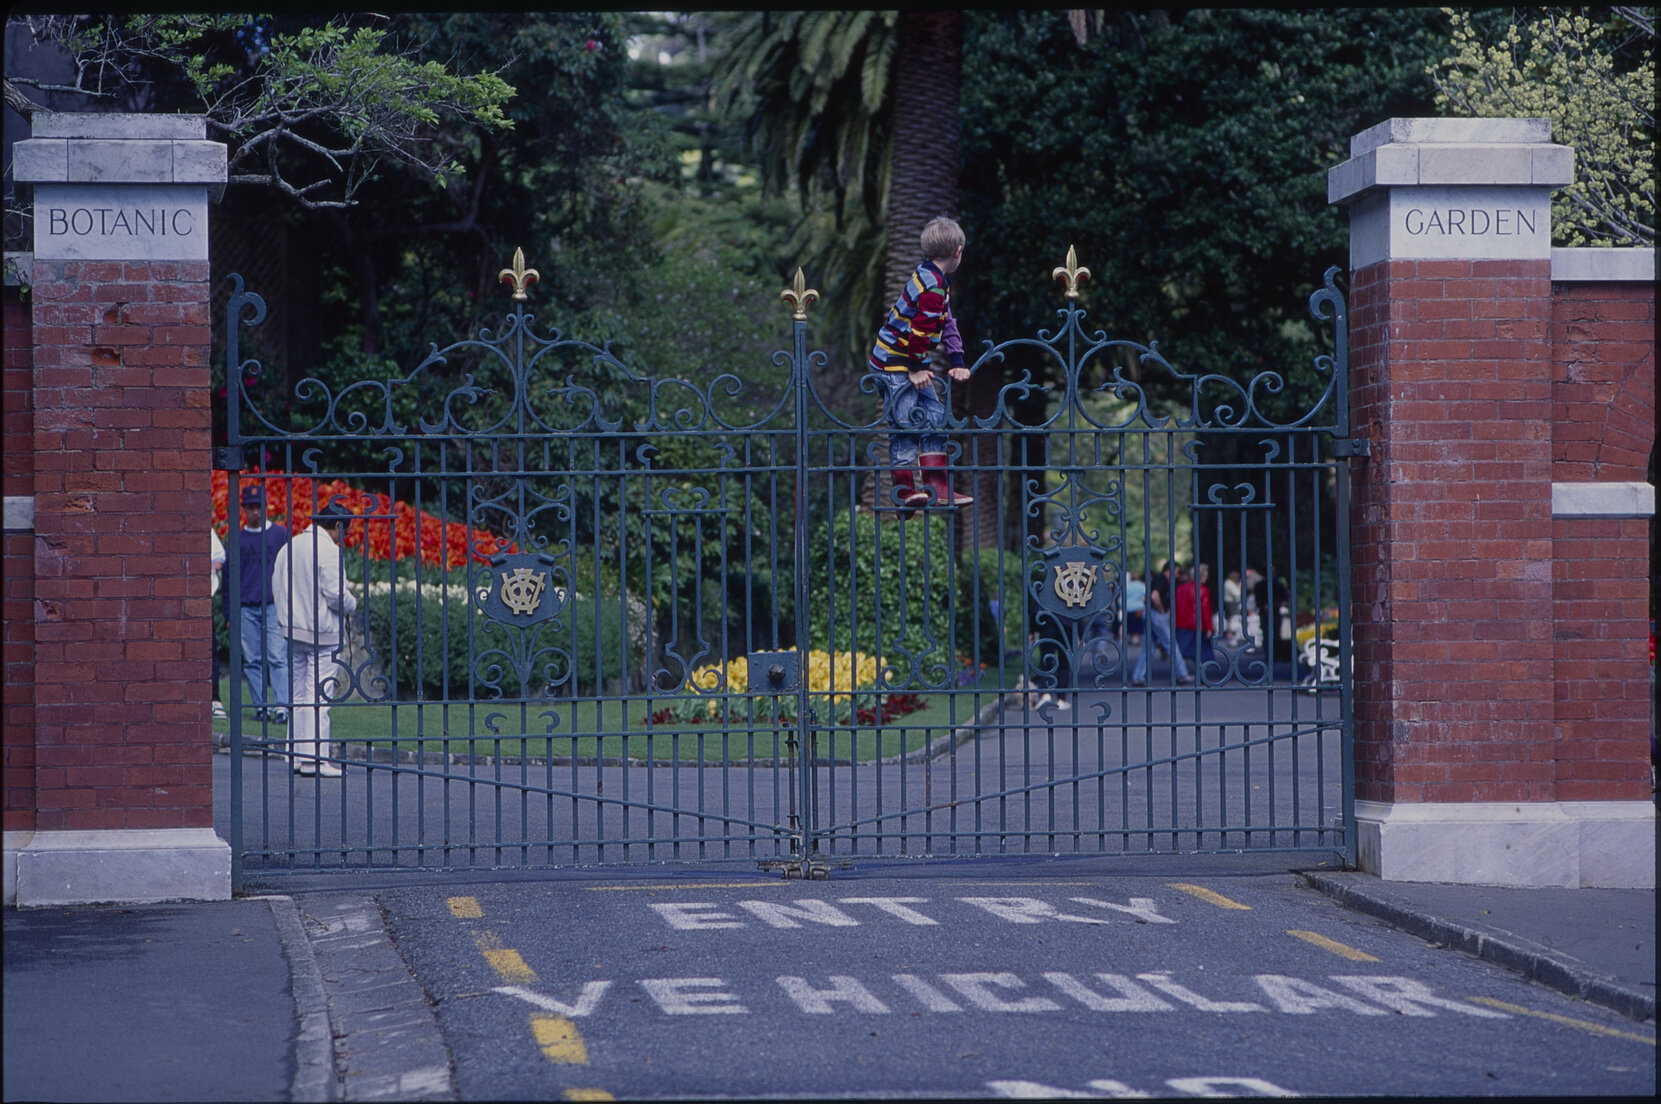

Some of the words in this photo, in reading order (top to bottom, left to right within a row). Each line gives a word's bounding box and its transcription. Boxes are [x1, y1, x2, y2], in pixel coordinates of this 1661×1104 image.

[48, 208, 193, 236] BOTANIC
[1405, 208, 1536, 236] GARDEN
[650, 896, 1178, 931] ENTRY
[494, 971, 1514, 1019] VEHICULAR
